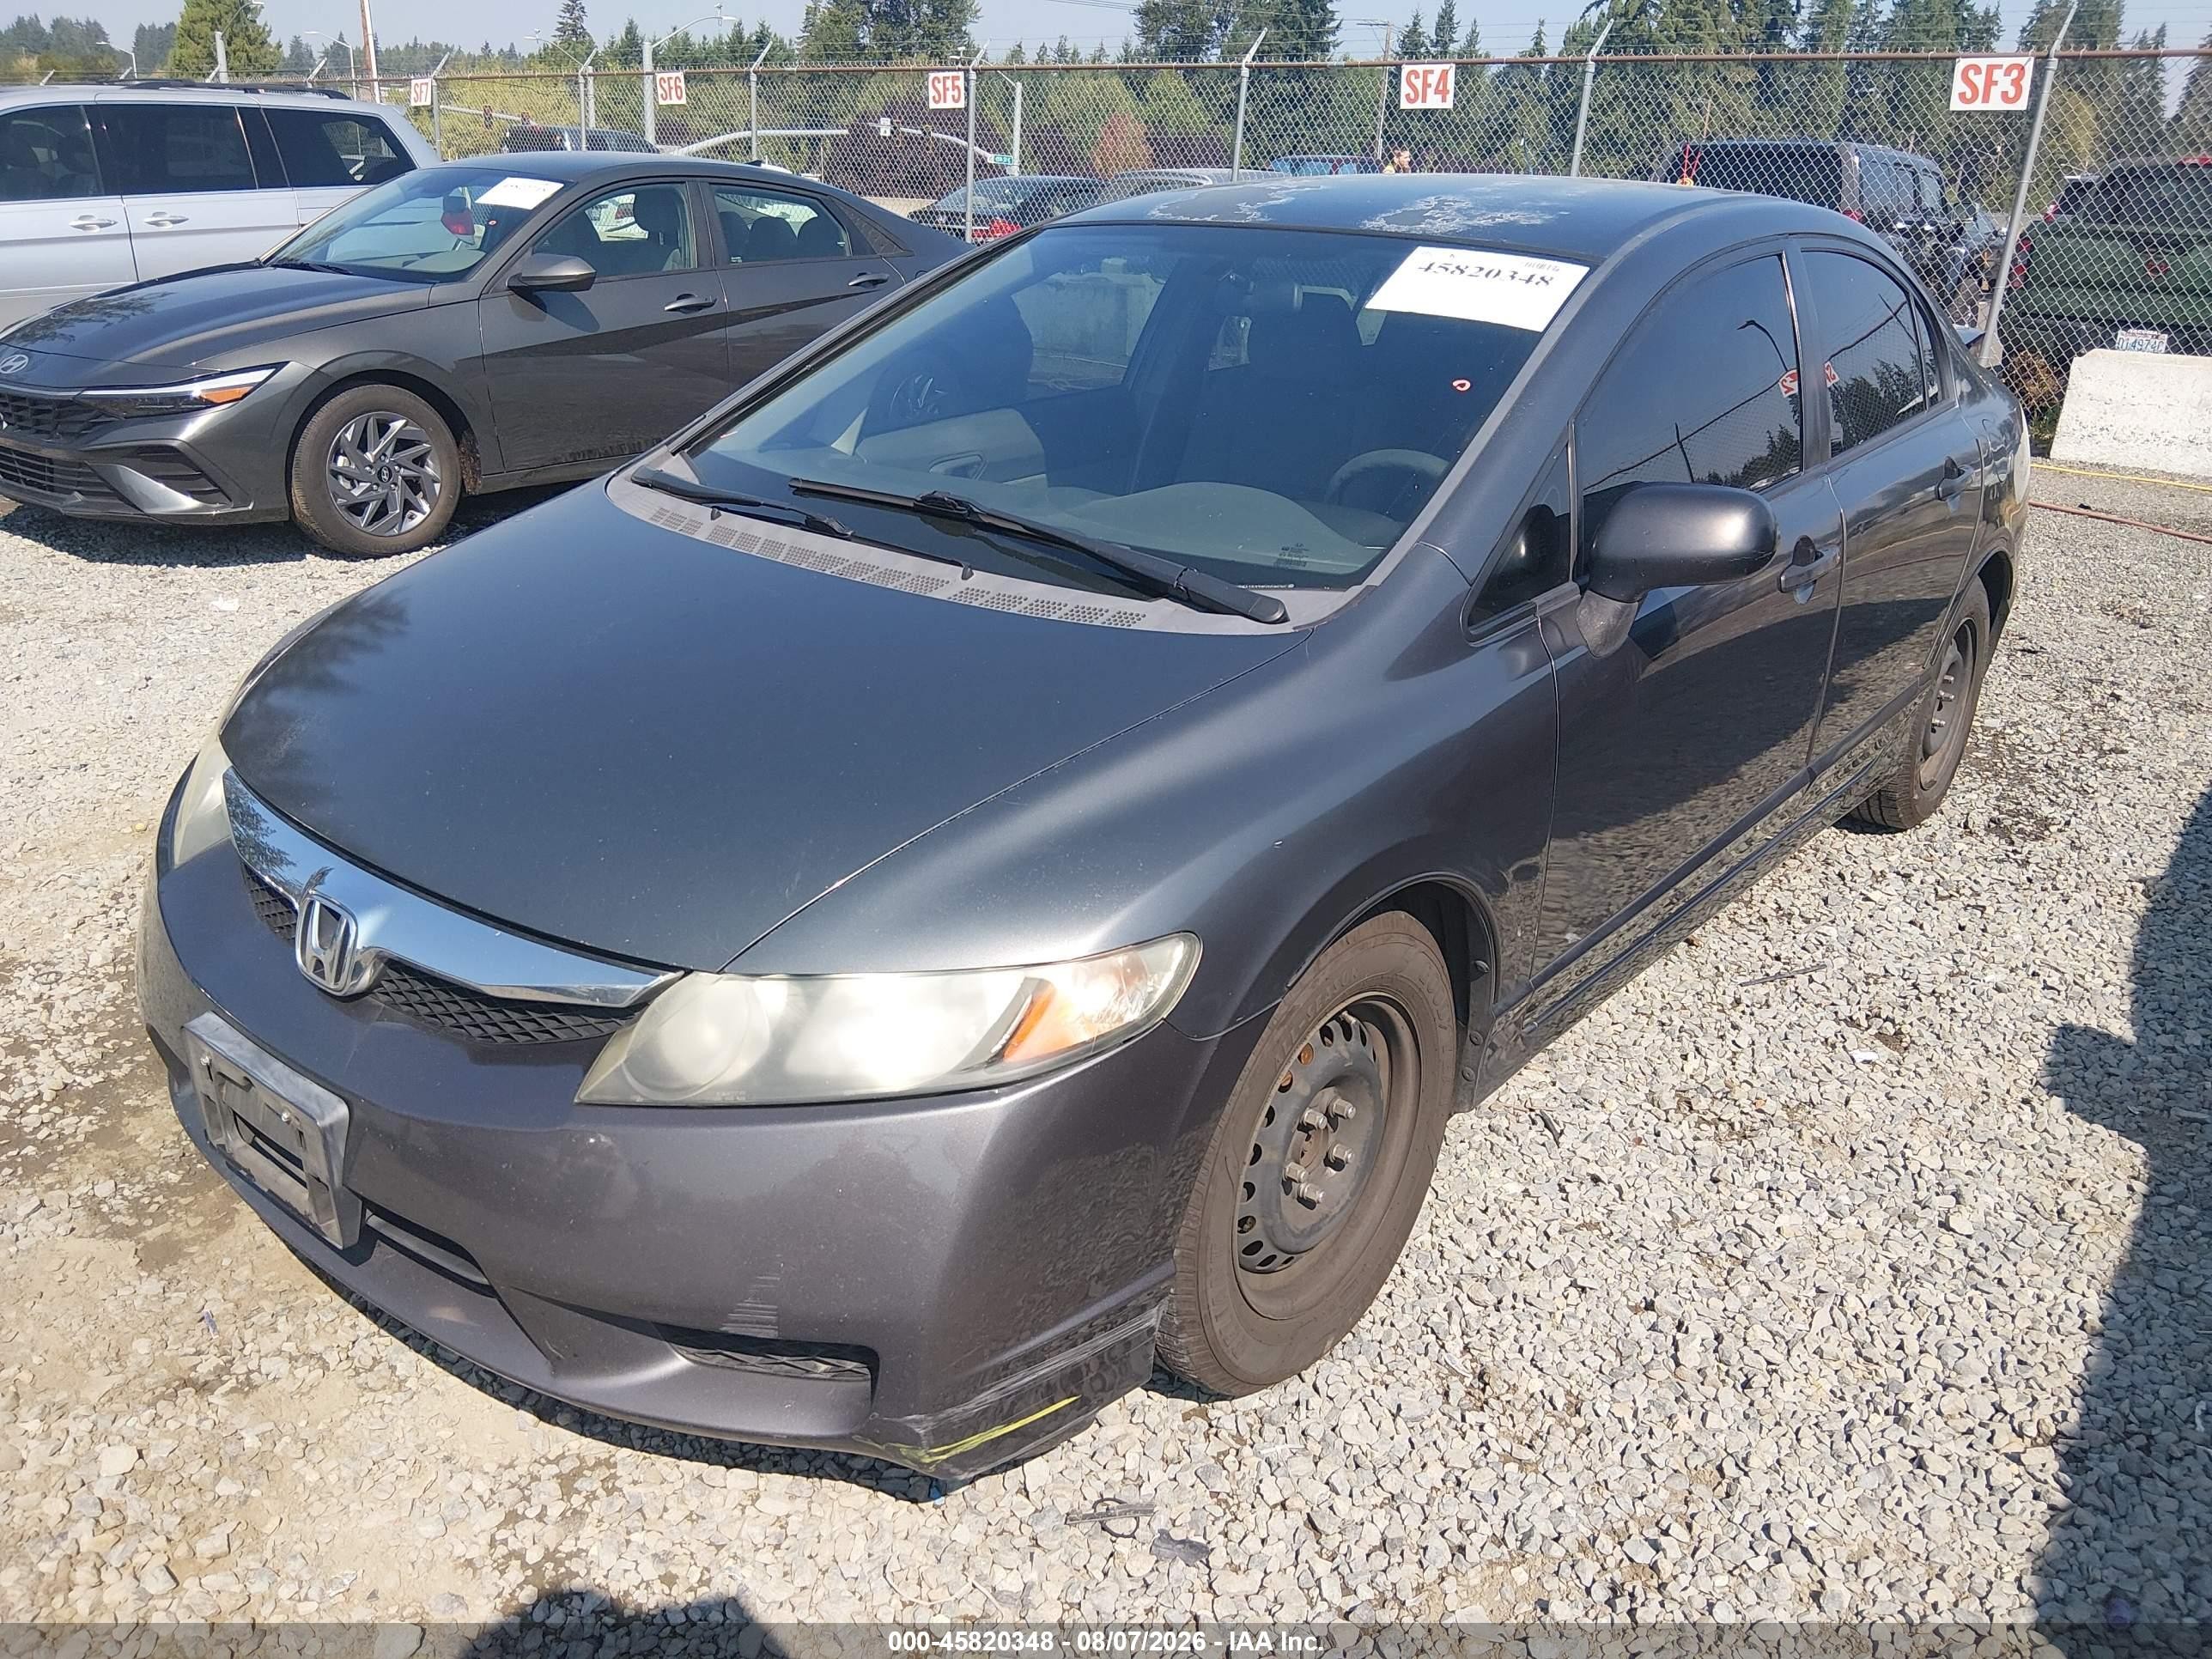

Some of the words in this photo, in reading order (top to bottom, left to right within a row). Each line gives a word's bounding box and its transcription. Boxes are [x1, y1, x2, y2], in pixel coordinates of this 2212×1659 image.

[413, 82, 429, 104] SF7
[659, 76, 684, 101] SF6
[931, 75, 962, 105] SF5
[1404, 69, 1449, 104] SF4
[1958, 63, 2026, 105] SF3
[1417, 261, 1554, 286] 45820348
